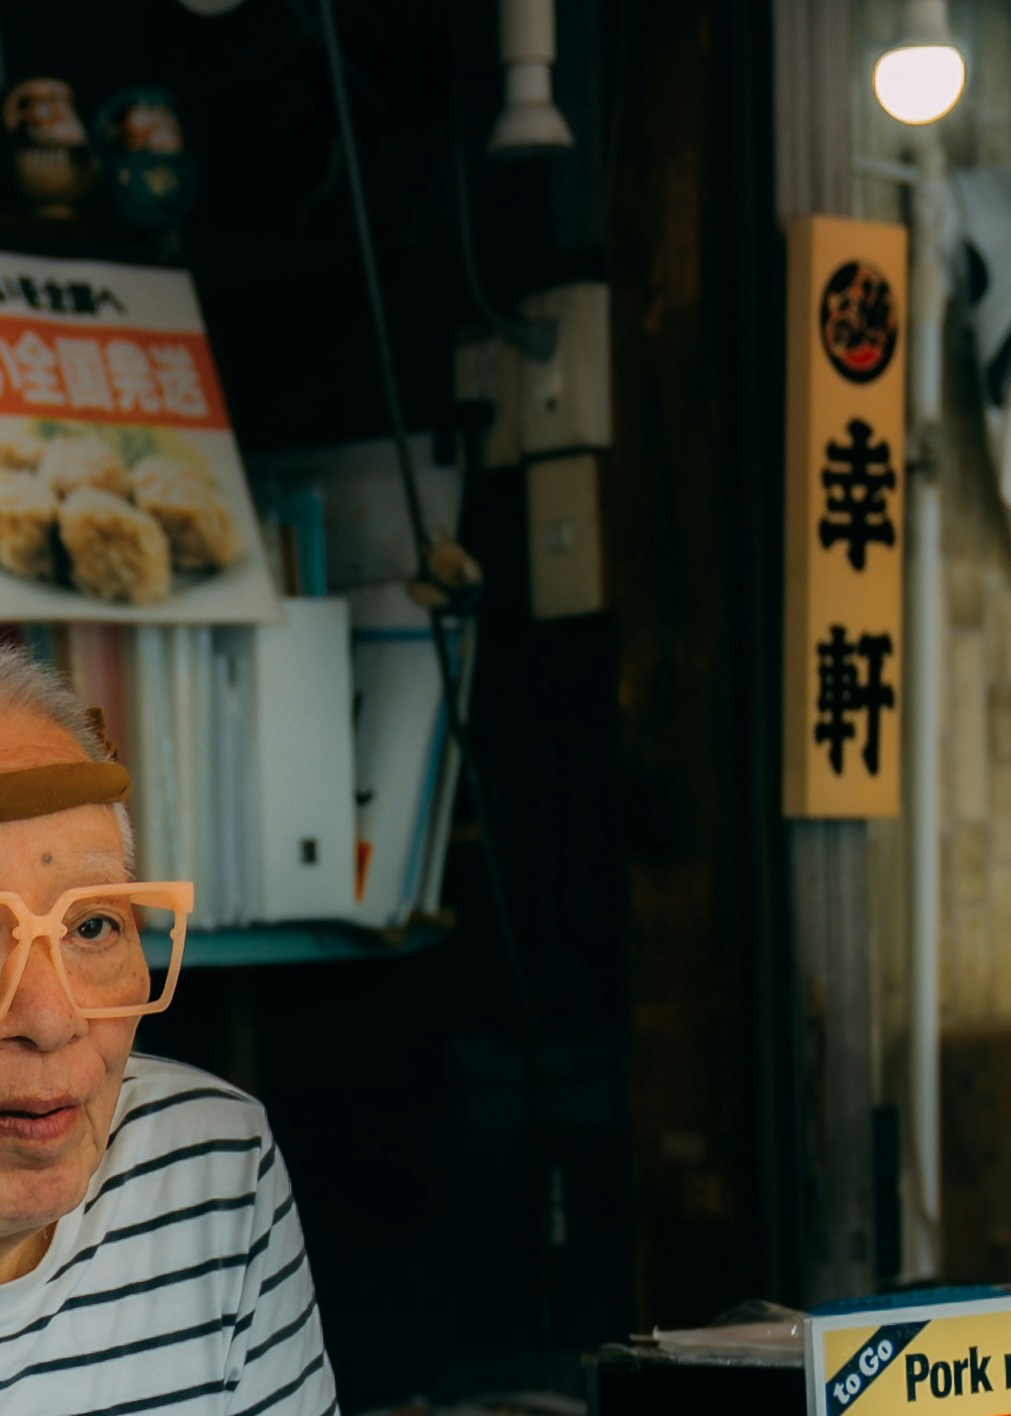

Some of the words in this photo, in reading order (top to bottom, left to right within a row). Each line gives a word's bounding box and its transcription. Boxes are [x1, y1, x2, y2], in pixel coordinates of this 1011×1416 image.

[815, 417, 897, 777] 幸軒
[833, 1373, 862, 1405] to
[858, 1338, 894, 1377] Go
[904, 1345, 994, 1403] Pork
